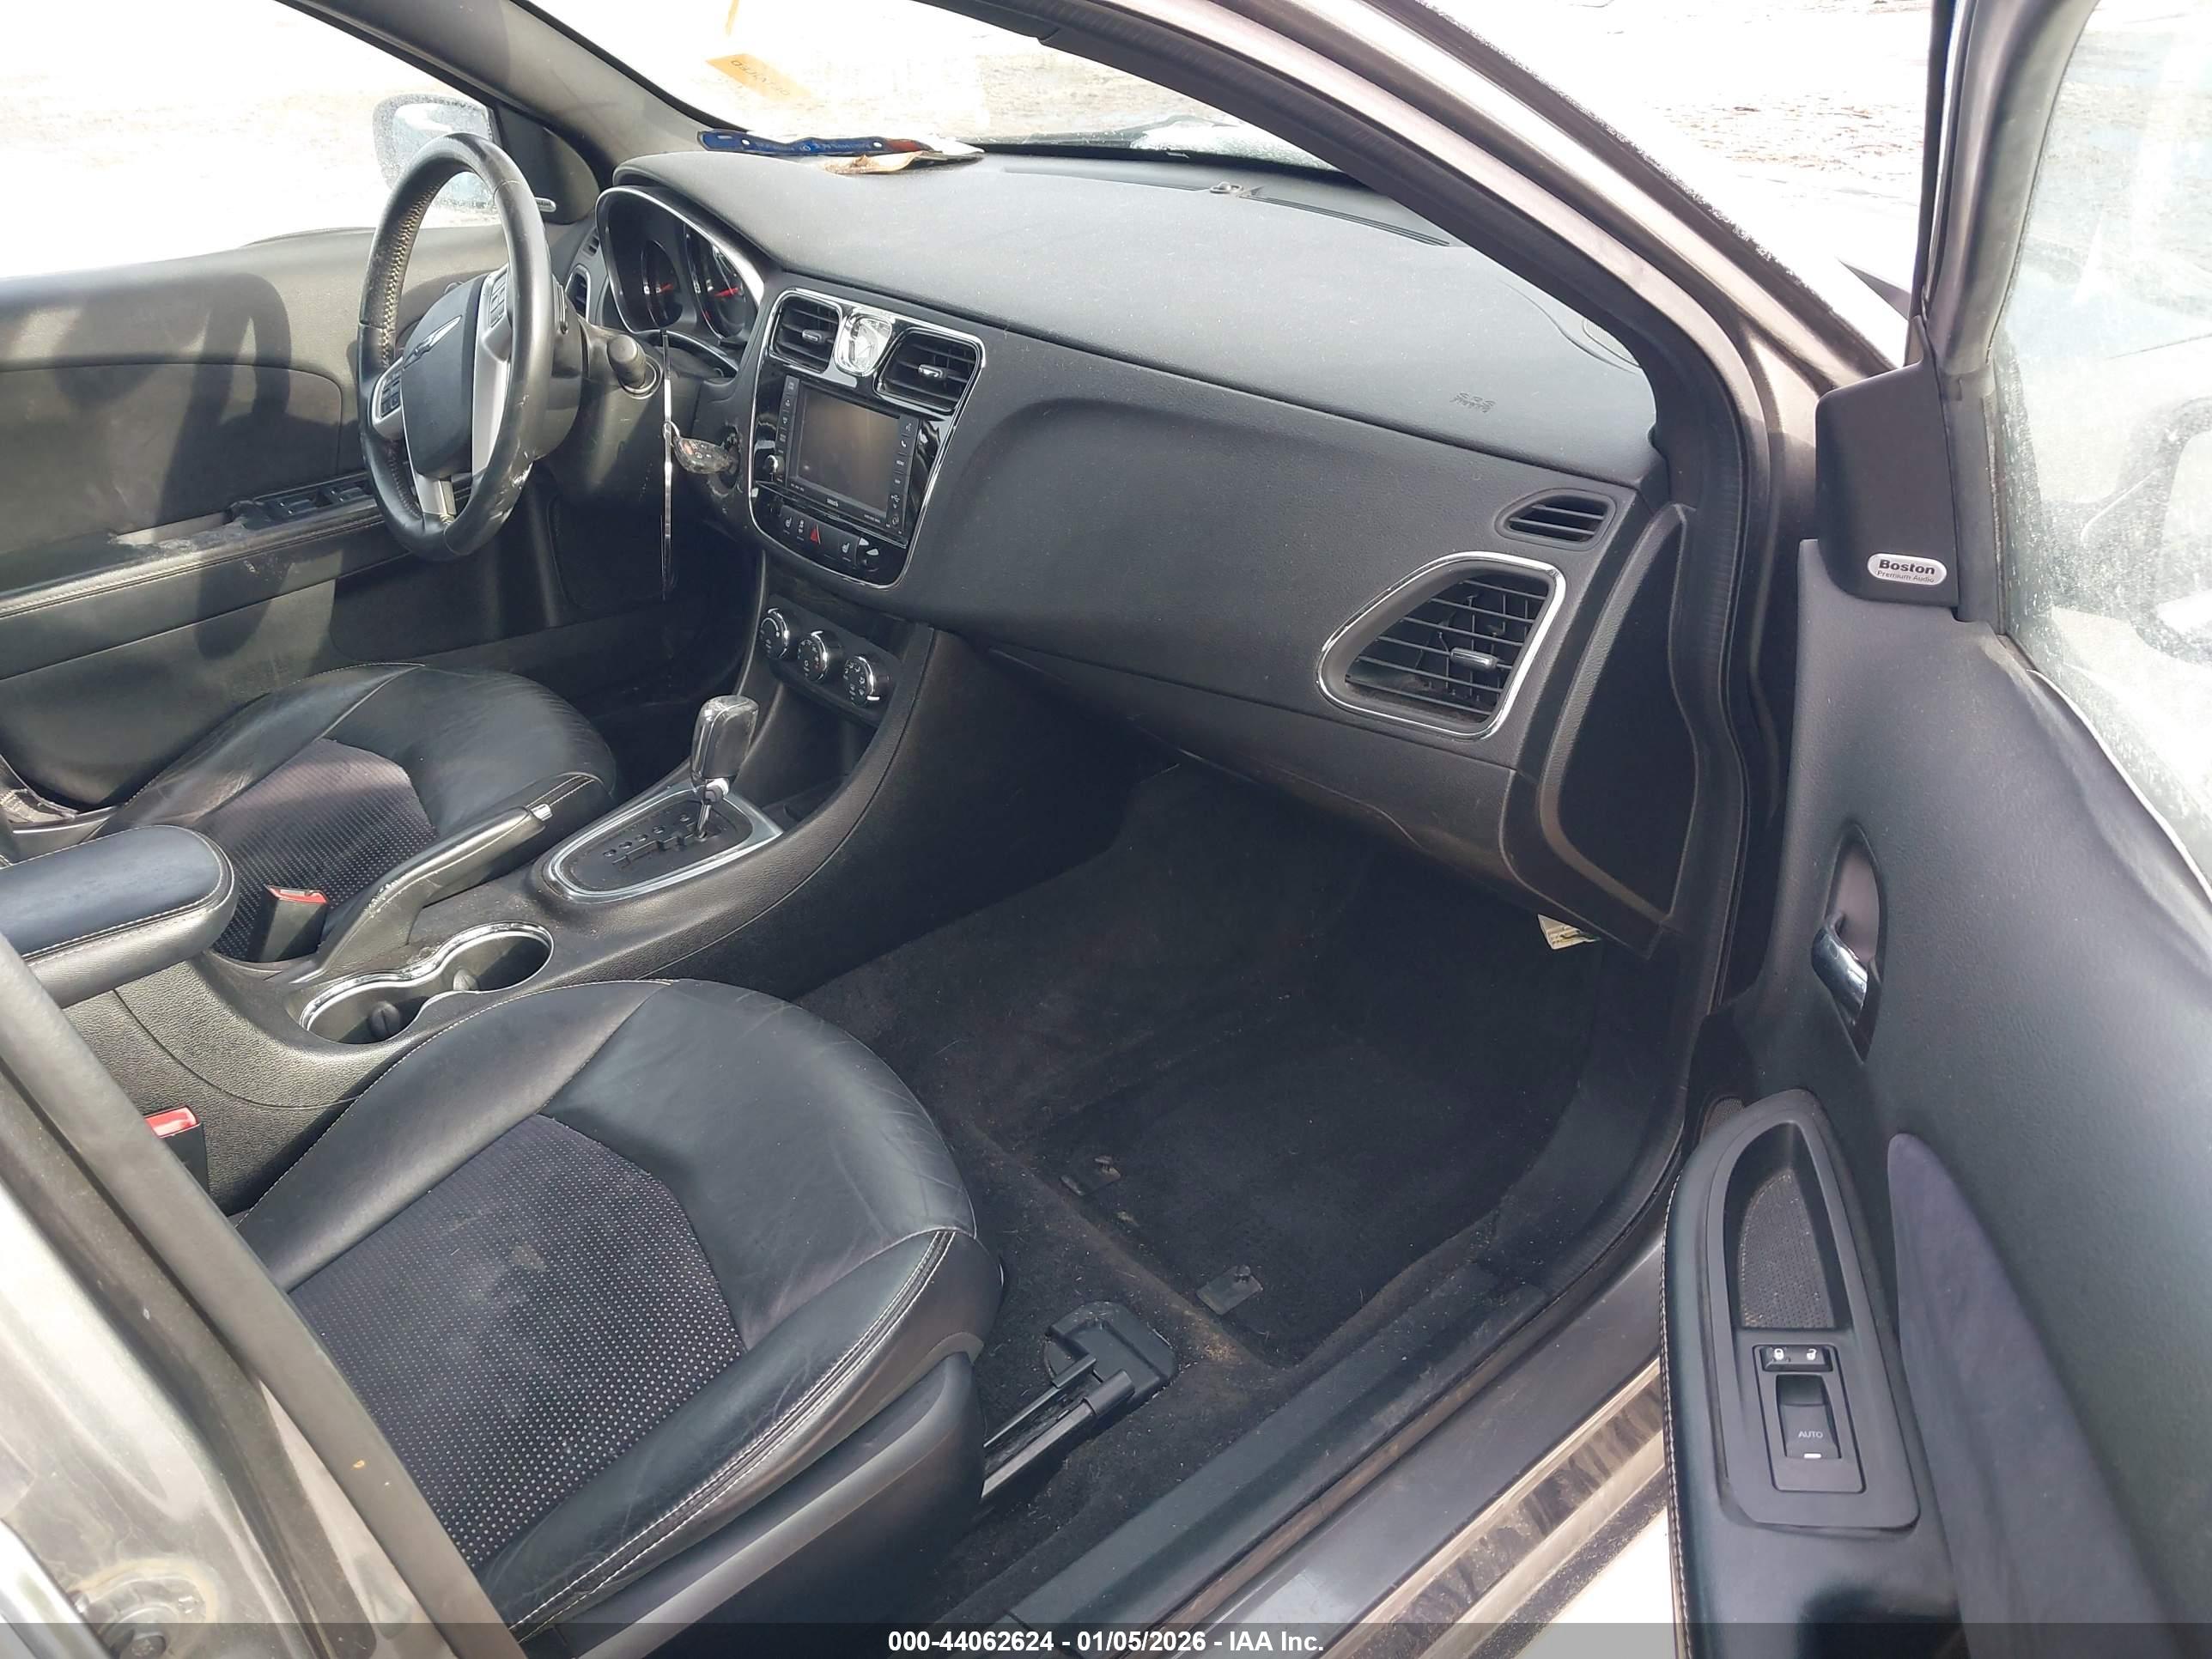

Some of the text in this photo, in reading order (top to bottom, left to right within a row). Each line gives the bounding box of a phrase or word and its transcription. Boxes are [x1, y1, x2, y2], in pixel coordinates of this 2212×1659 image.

[1879, 559, 1936, 574] Boston
[1877, 570, 1935, 583] Premium Audio
[1797, 1431, 1824, 1439] AUTO
